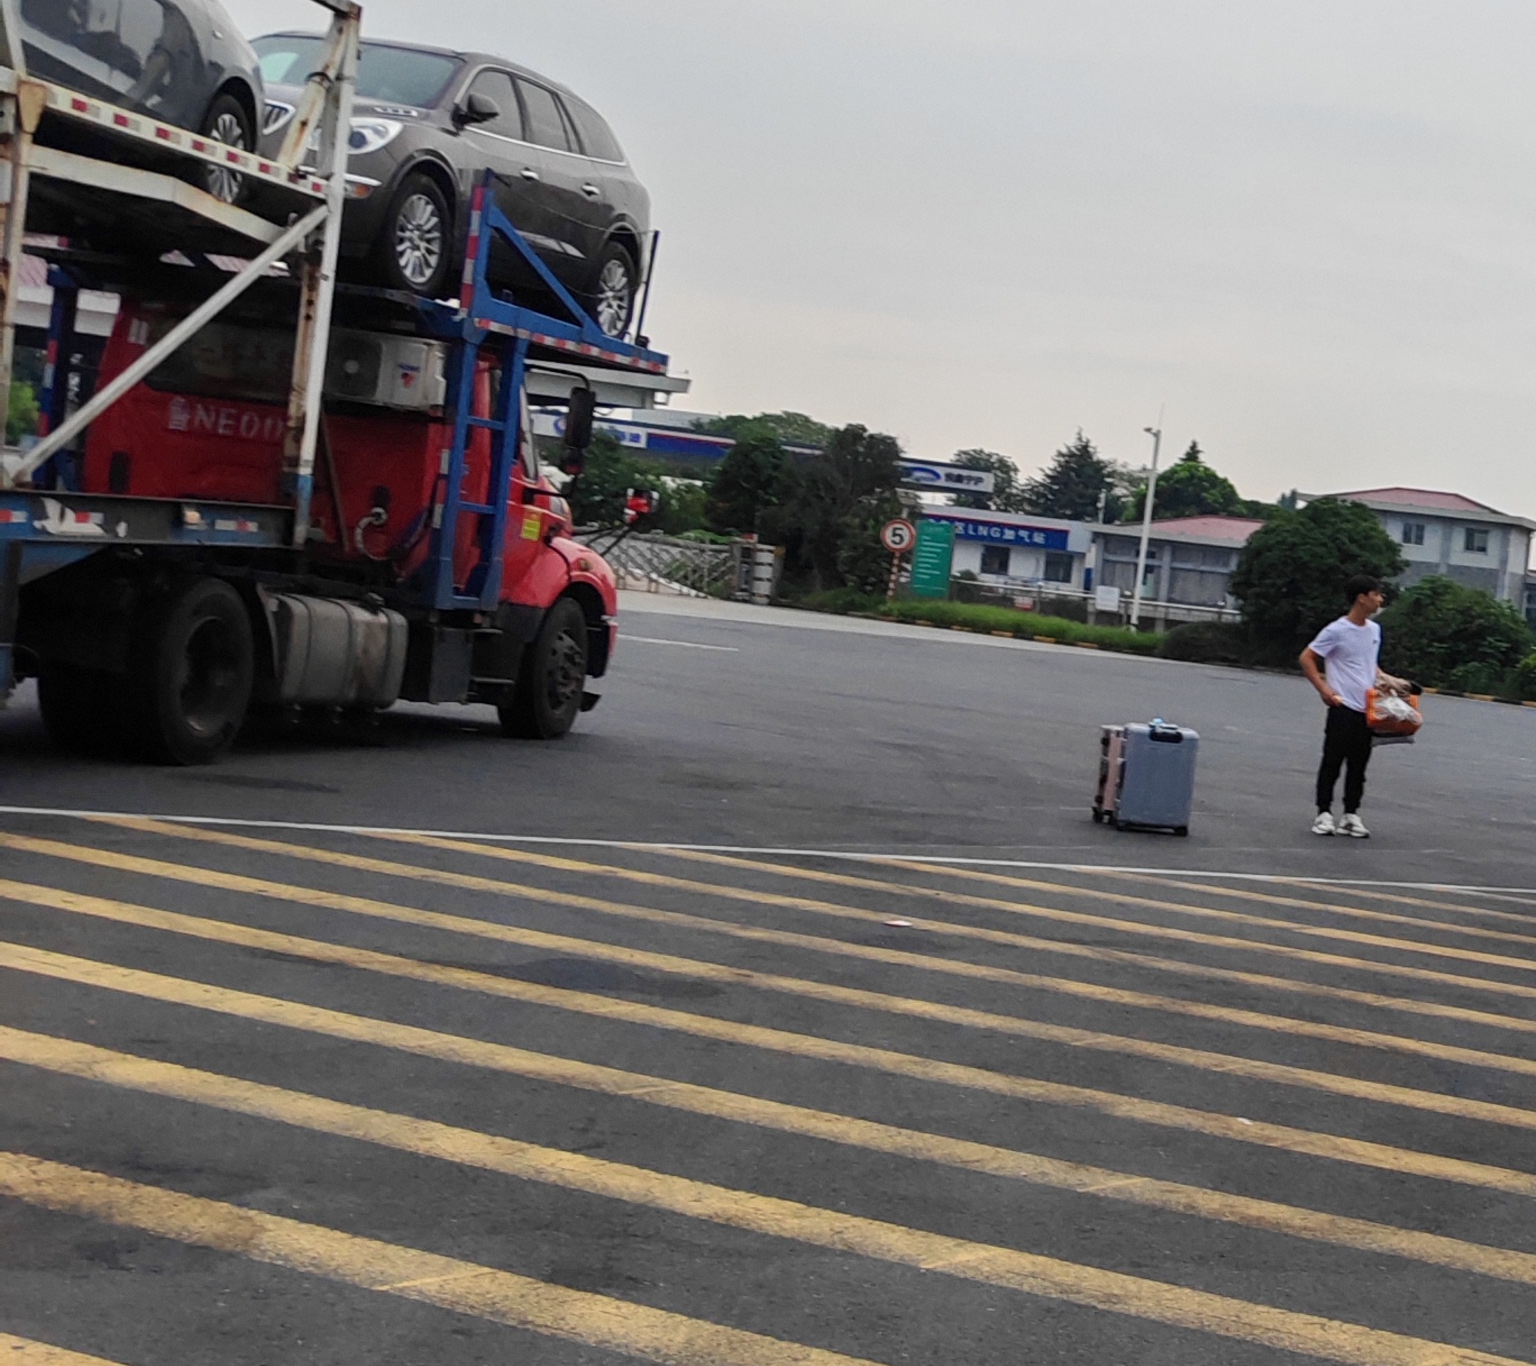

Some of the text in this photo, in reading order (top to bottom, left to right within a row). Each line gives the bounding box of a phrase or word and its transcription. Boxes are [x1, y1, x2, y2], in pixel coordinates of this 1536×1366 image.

[890, 526, 905, 546] 5
[928, 518, 1048, 546] 区LNG加气站
